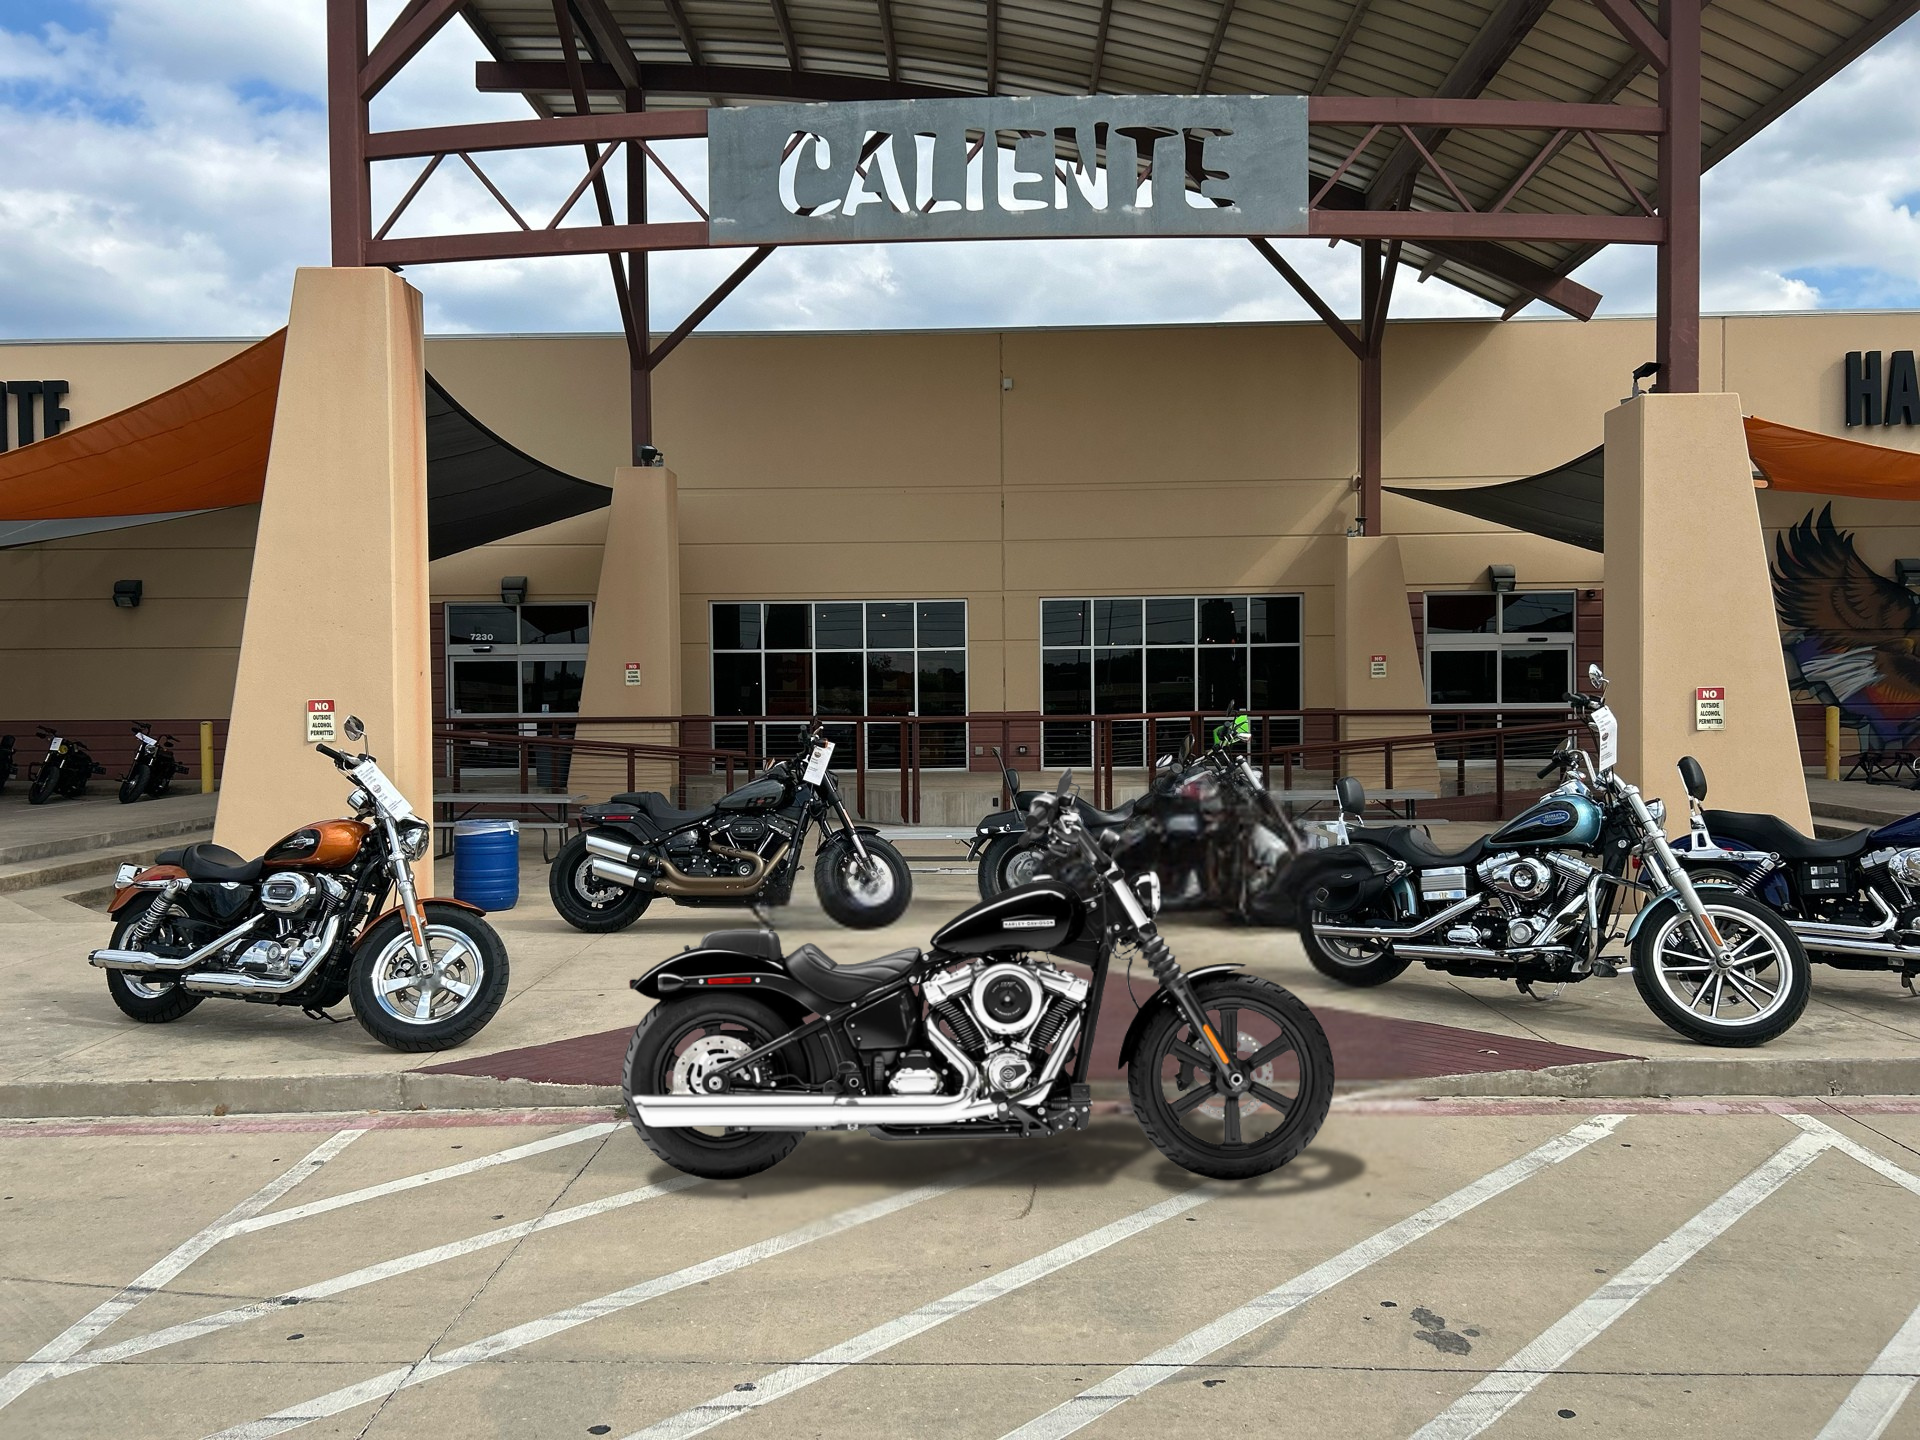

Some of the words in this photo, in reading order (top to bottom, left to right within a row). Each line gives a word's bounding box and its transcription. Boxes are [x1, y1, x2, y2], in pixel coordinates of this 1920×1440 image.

[779, 121, 1236, 217] CALIENTE
[1702, 690, 1717, 698] NO
[314, 702, 329, 710] NO
